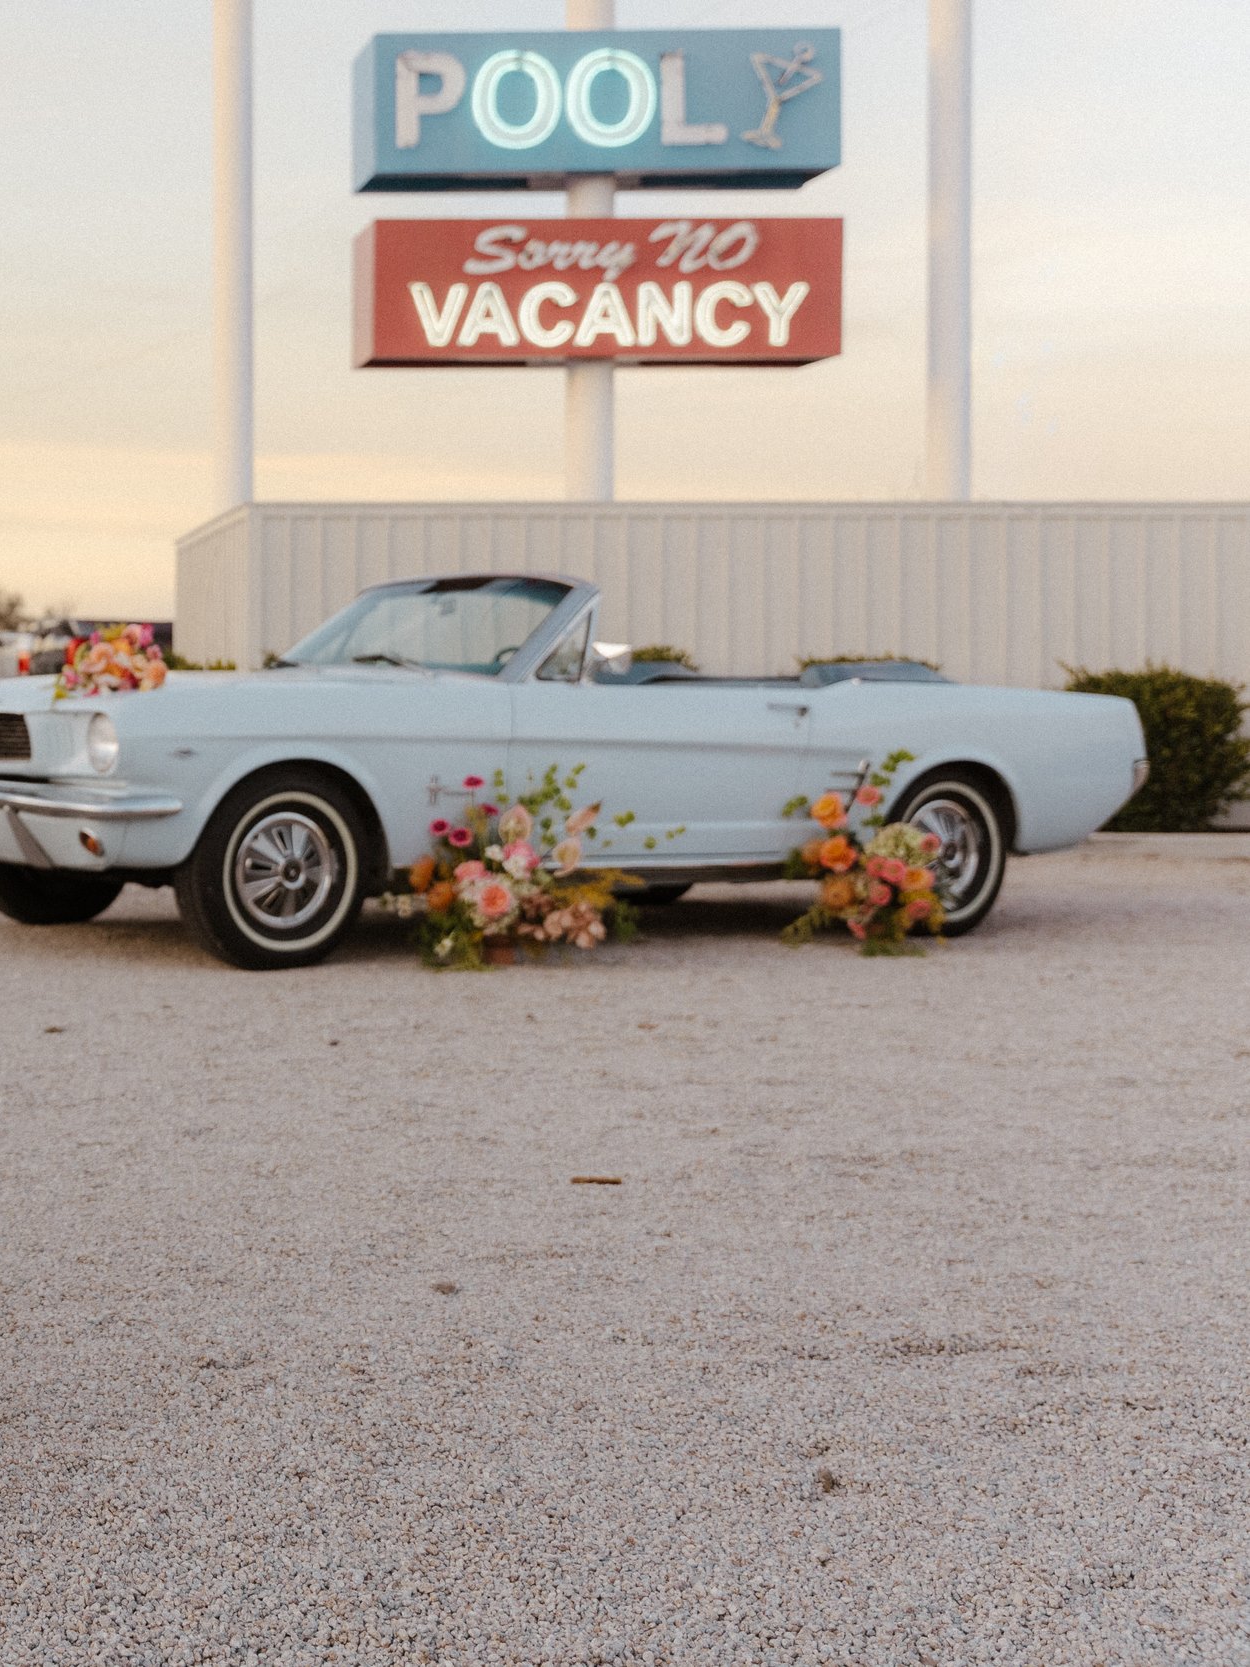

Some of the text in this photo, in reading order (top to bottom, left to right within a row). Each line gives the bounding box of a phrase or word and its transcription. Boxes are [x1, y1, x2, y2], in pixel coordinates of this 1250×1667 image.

[395, 48, 728, 150] POOL
[464, 221, 759, 281] Sorry NO
[409, 281, 810, 348] VACANCY
